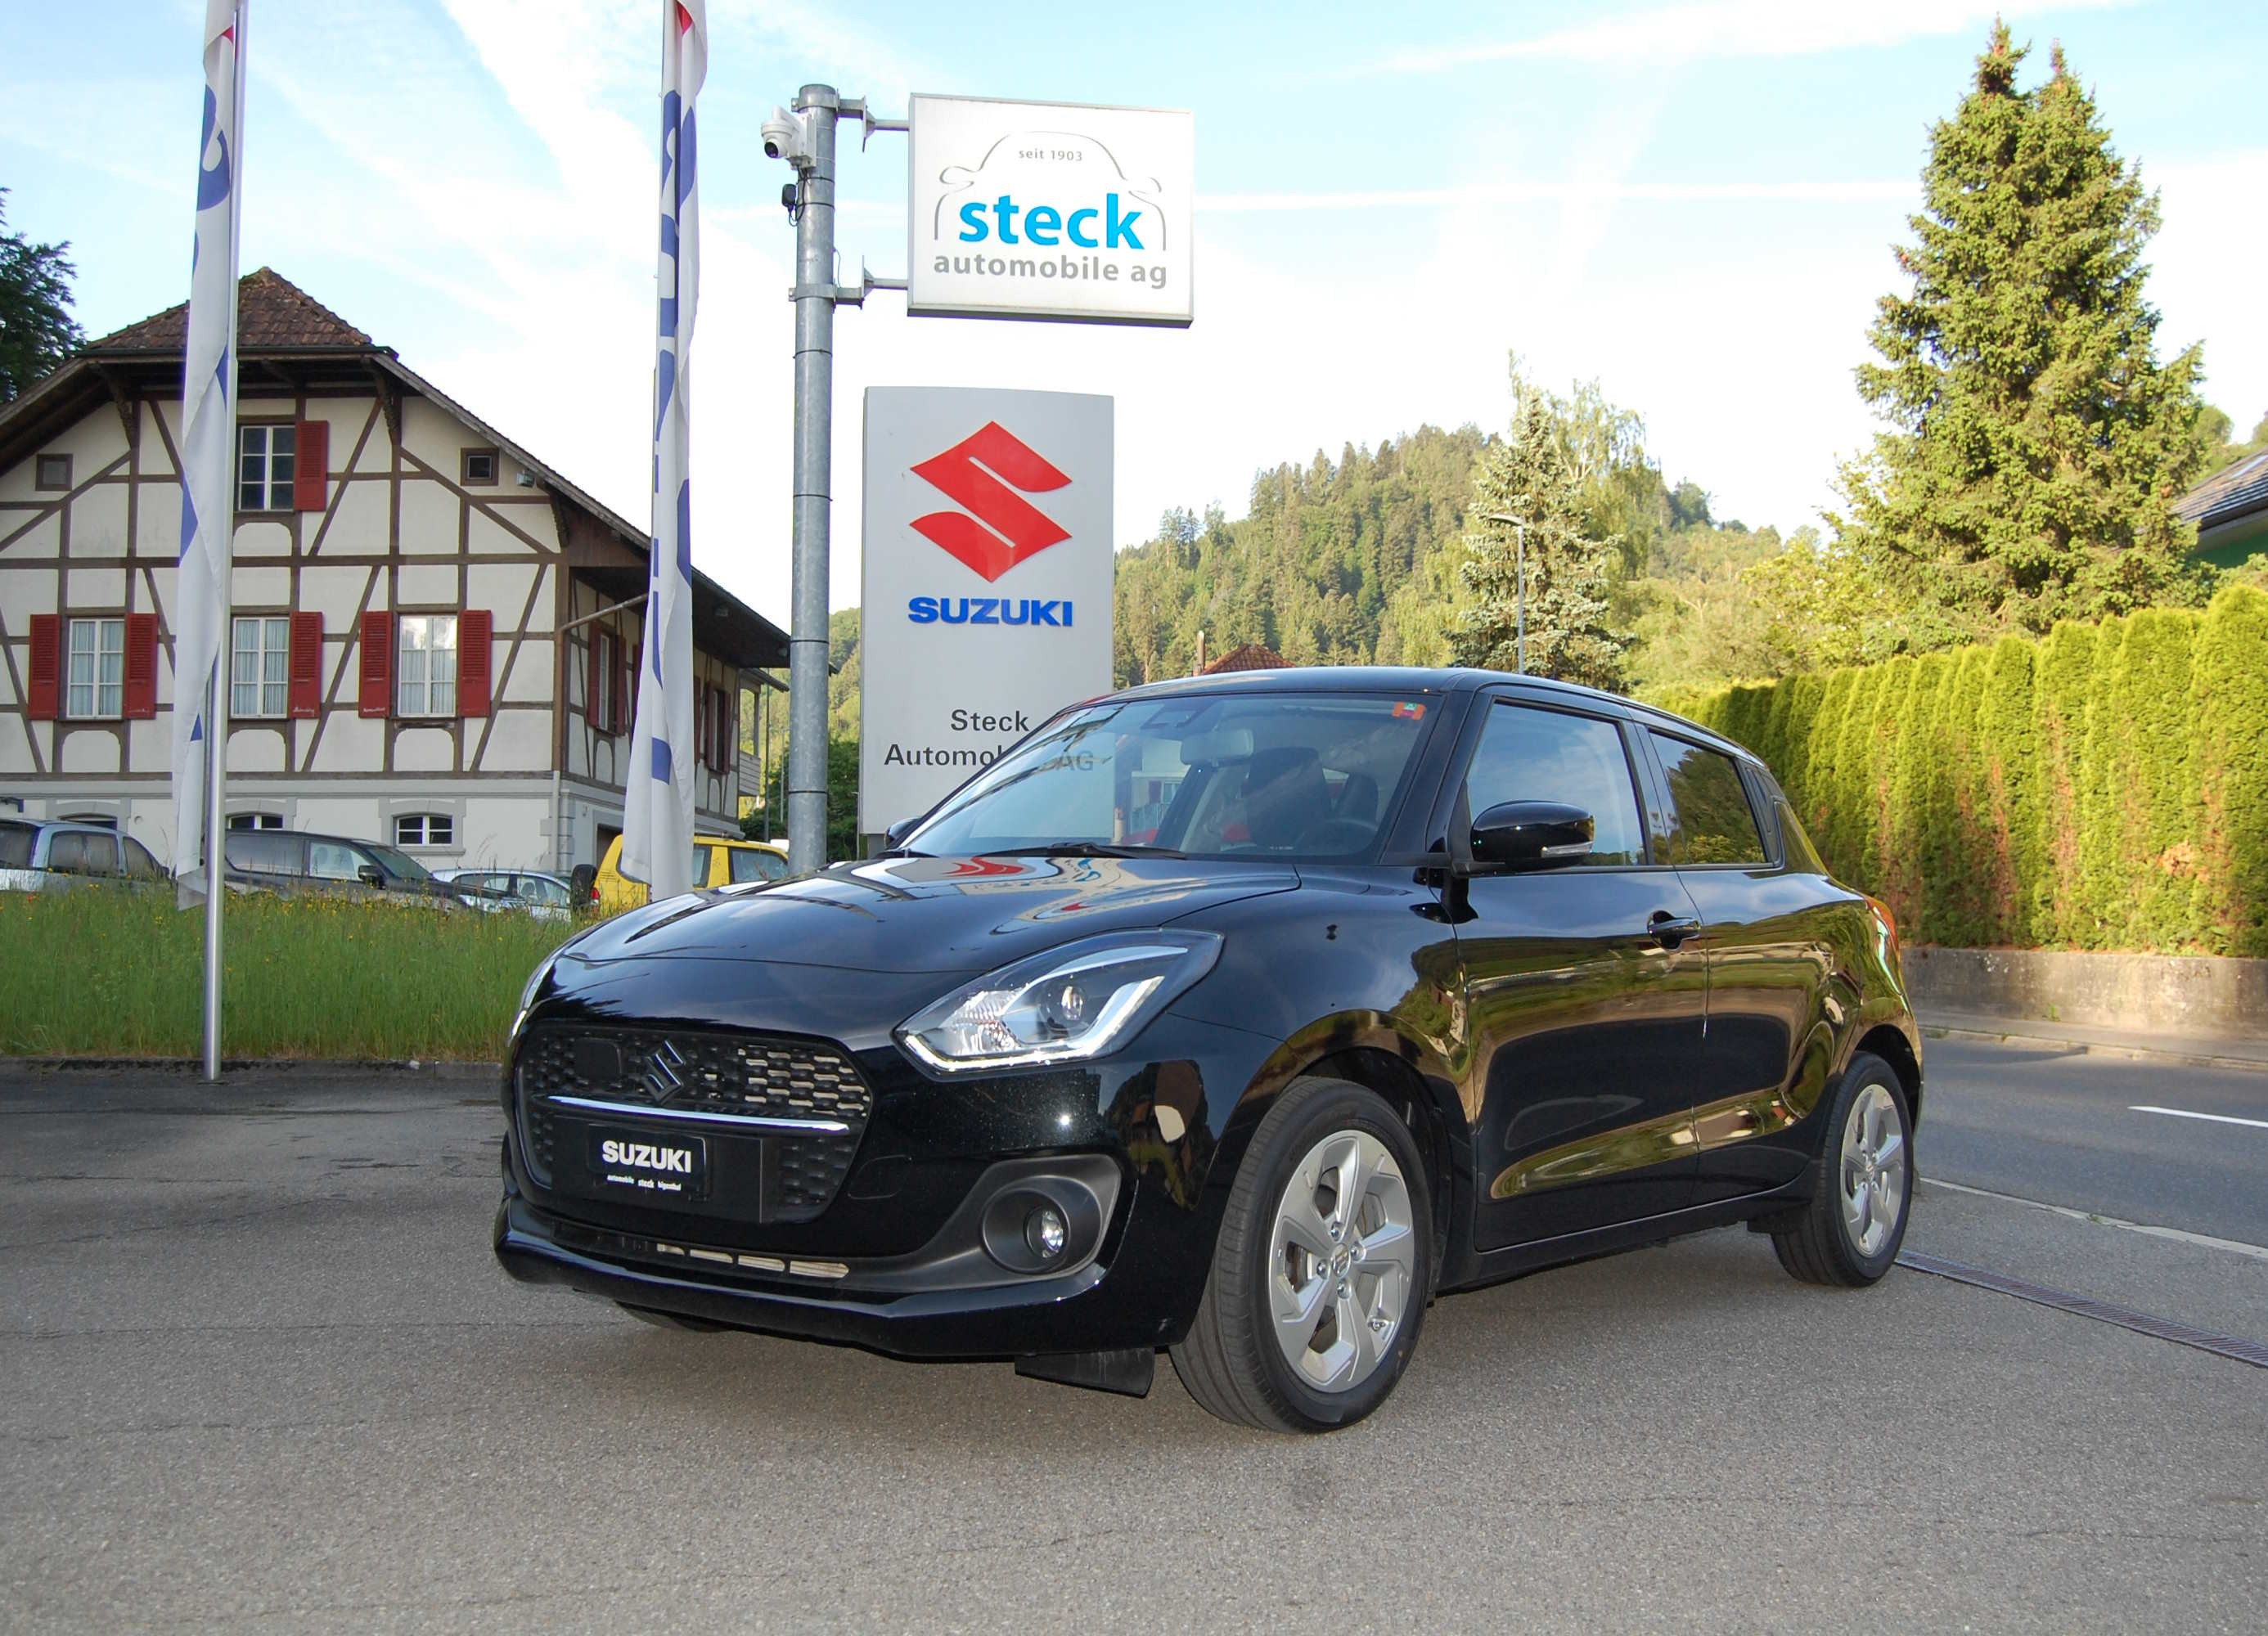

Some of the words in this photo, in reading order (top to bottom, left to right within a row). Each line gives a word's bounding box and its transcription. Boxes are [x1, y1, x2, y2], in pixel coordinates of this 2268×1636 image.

[1018, 148, 1045, 160] seit
[1051, 150, 1082, 162] 1903
[959, 193, 1145, 249] steck
[934, 254, 1119, 281] automobile
[1130, 265, 1168, 290] ag
[908, 596, 1073, 627] SUZUKI
[950, 709, 1029, 732] Steck
[884, 744, 1003, 766] Automo
[602, 1139, 692, 1174] SUZUKI
